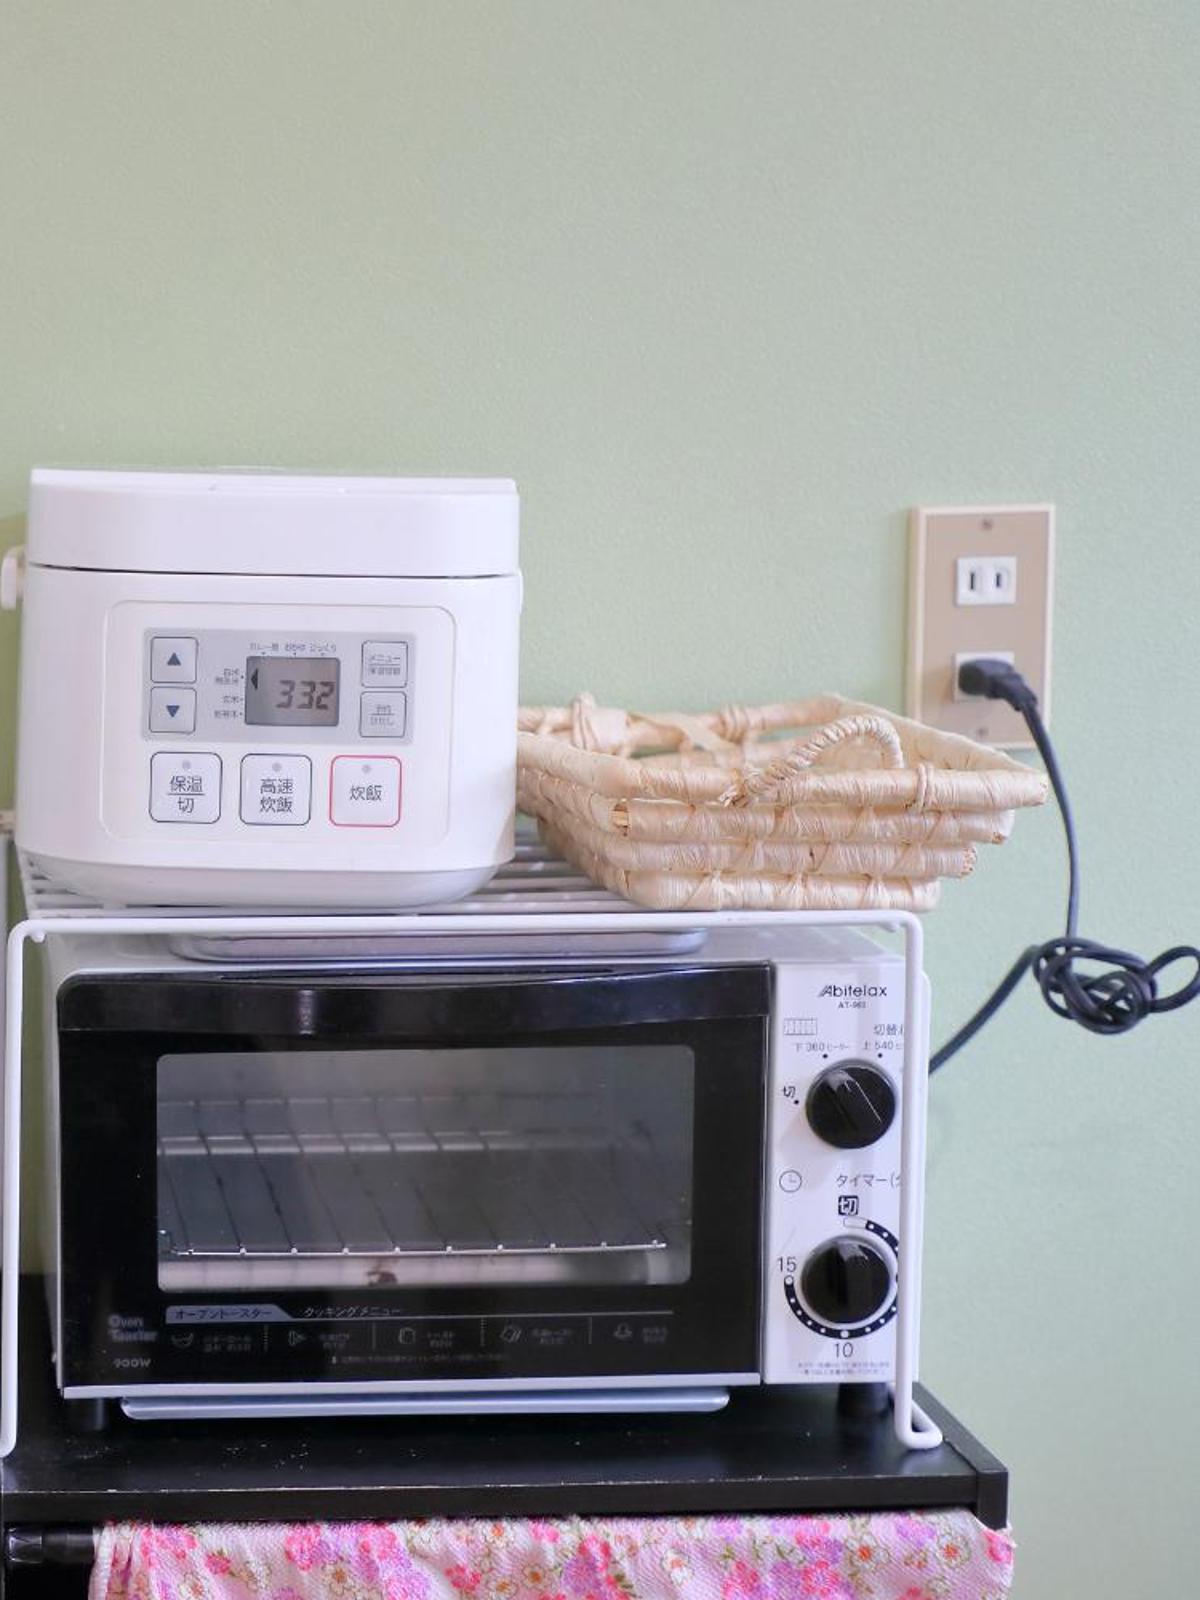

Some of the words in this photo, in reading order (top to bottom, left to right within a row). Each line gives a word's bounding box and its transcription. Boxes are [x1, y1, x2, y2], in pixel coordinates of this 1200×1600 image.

[169, 775, 203, 792] 保温
[260, 778, 293, 794] 高速
[350, 784, 382, 801] 炊飯
[178, 797, 195, 814] 切
[260, 797, 293, 813] 炊飯
[819, 985, 888, 997] Abitelax
[782, 1085, 796, 1099] 切
[839, 1196, 858, 1215] 切
[777, 1256, 797, 1272] 15
[175, 1307, 274, 1320] オーブントースター
[834, 1342, 854, 1358] 10
[113, 1357, 151, 1369] 900W
